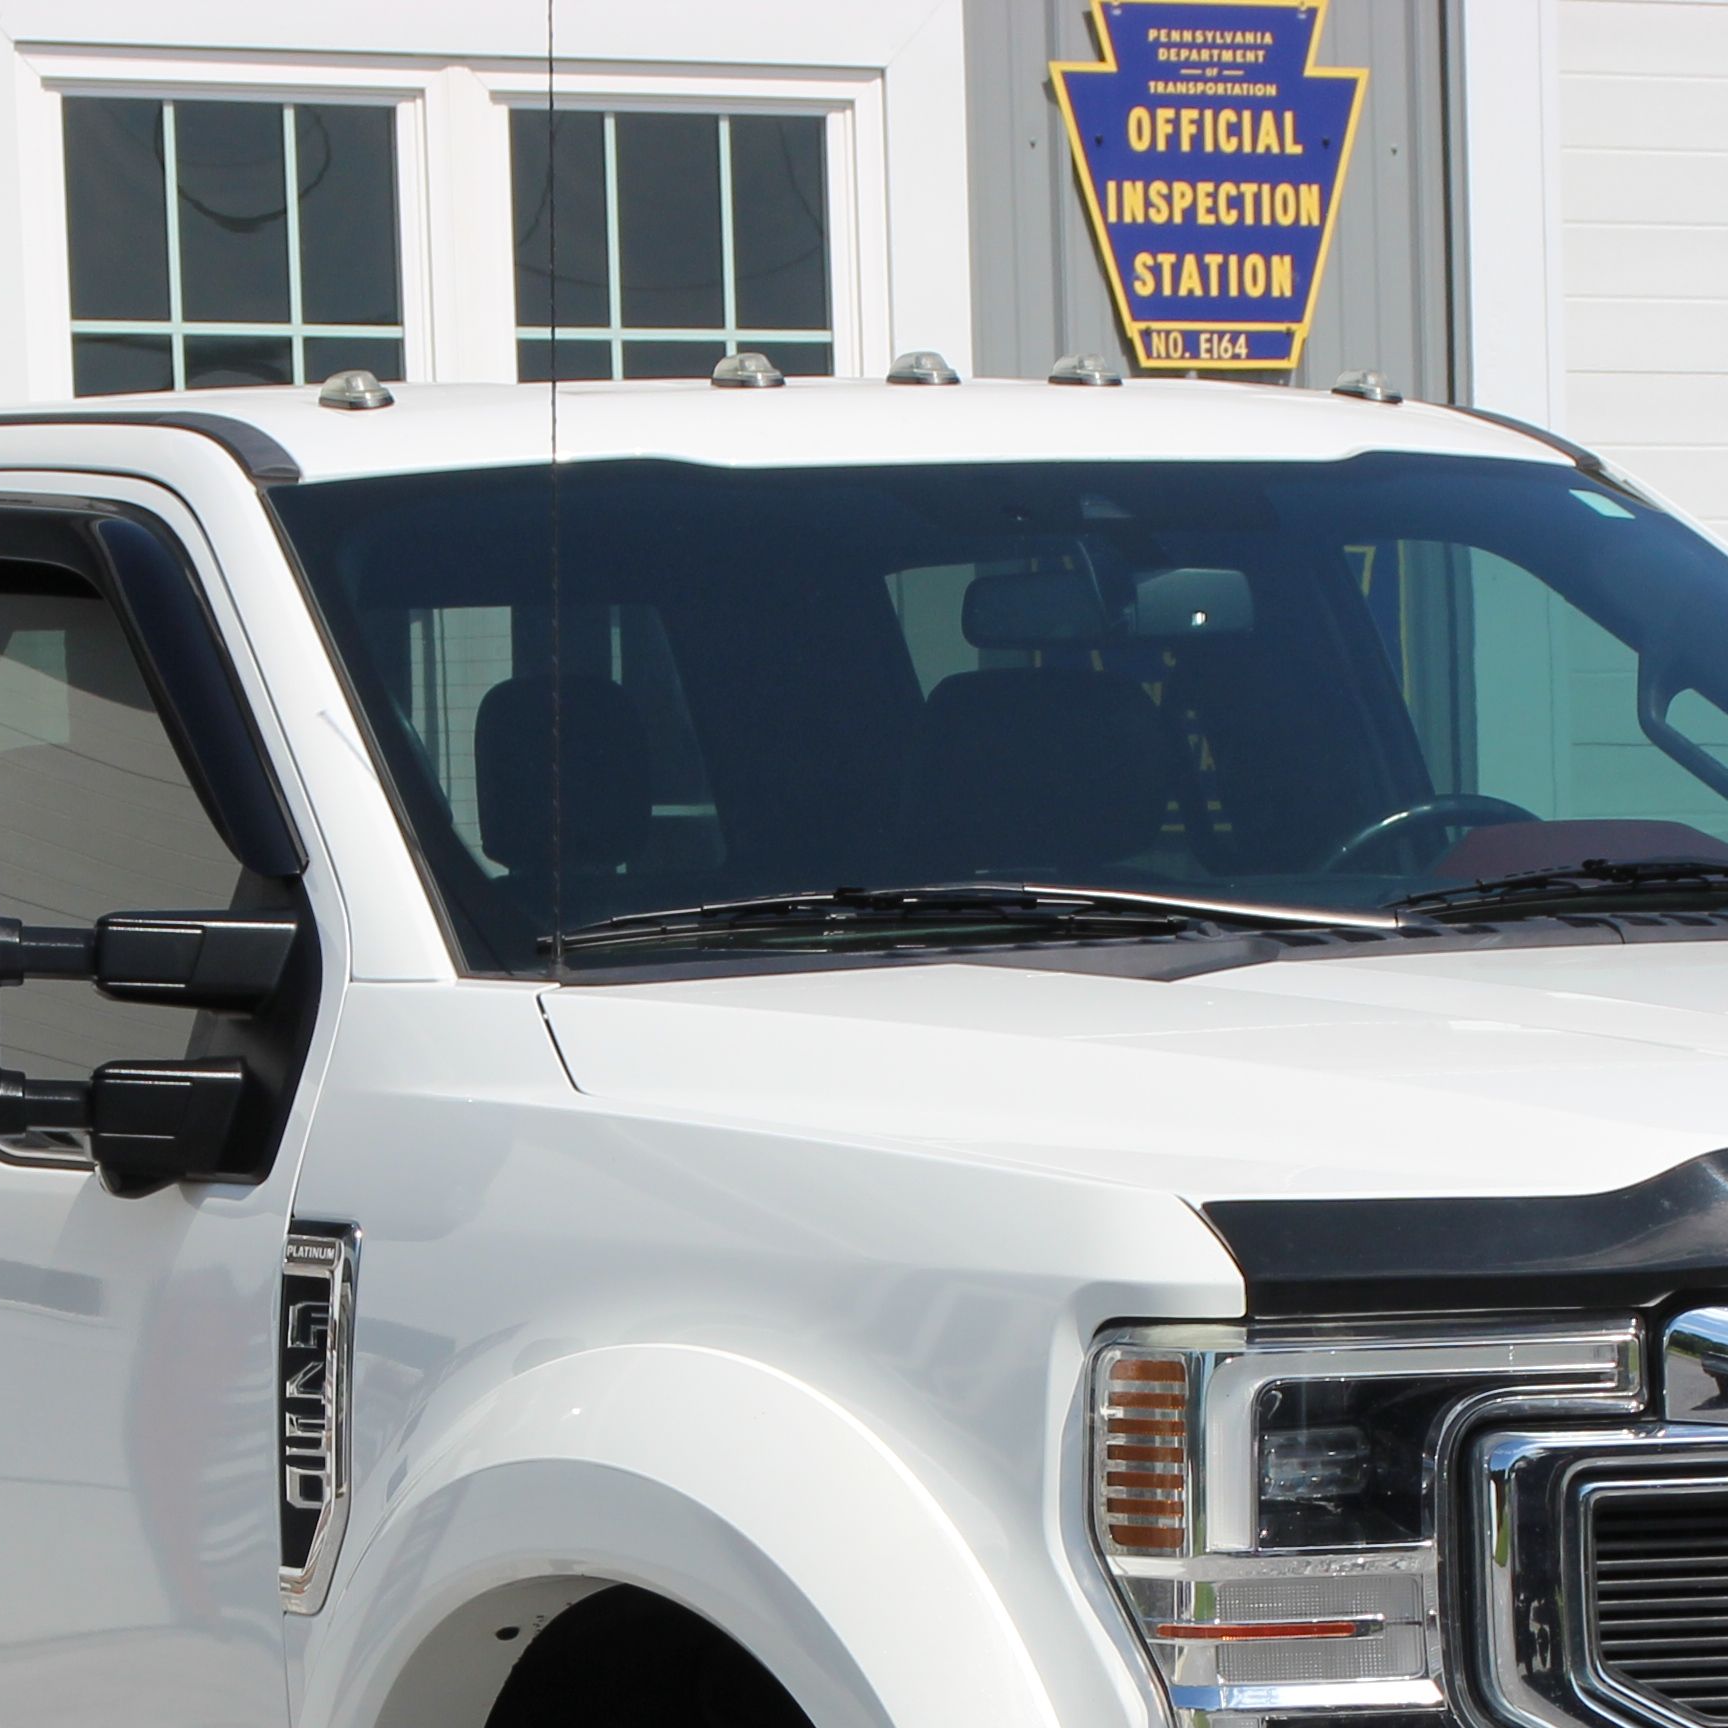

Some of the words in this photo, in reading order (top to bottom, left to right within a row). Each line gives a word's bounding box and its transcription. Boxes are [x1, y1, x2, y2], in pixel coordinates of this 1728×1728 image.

[1148, 29, 1273, 45] PENNSYLVANIA
[1158, 48, 1265, 63] DEPARTMENT
[1205, 67, 1219, 77] OF
[1148, 81, 1277, 96] TRANSPORTATION
[1127, 106, 1303, 155] OFFICIAL
[1106, 180, 1321, 226] INSPECTION
[1133, 252, 1293, 297] STATION
[1151, 331, 1191, 359] NO.
[286, 1244, 335, 1260] PLATINUM
